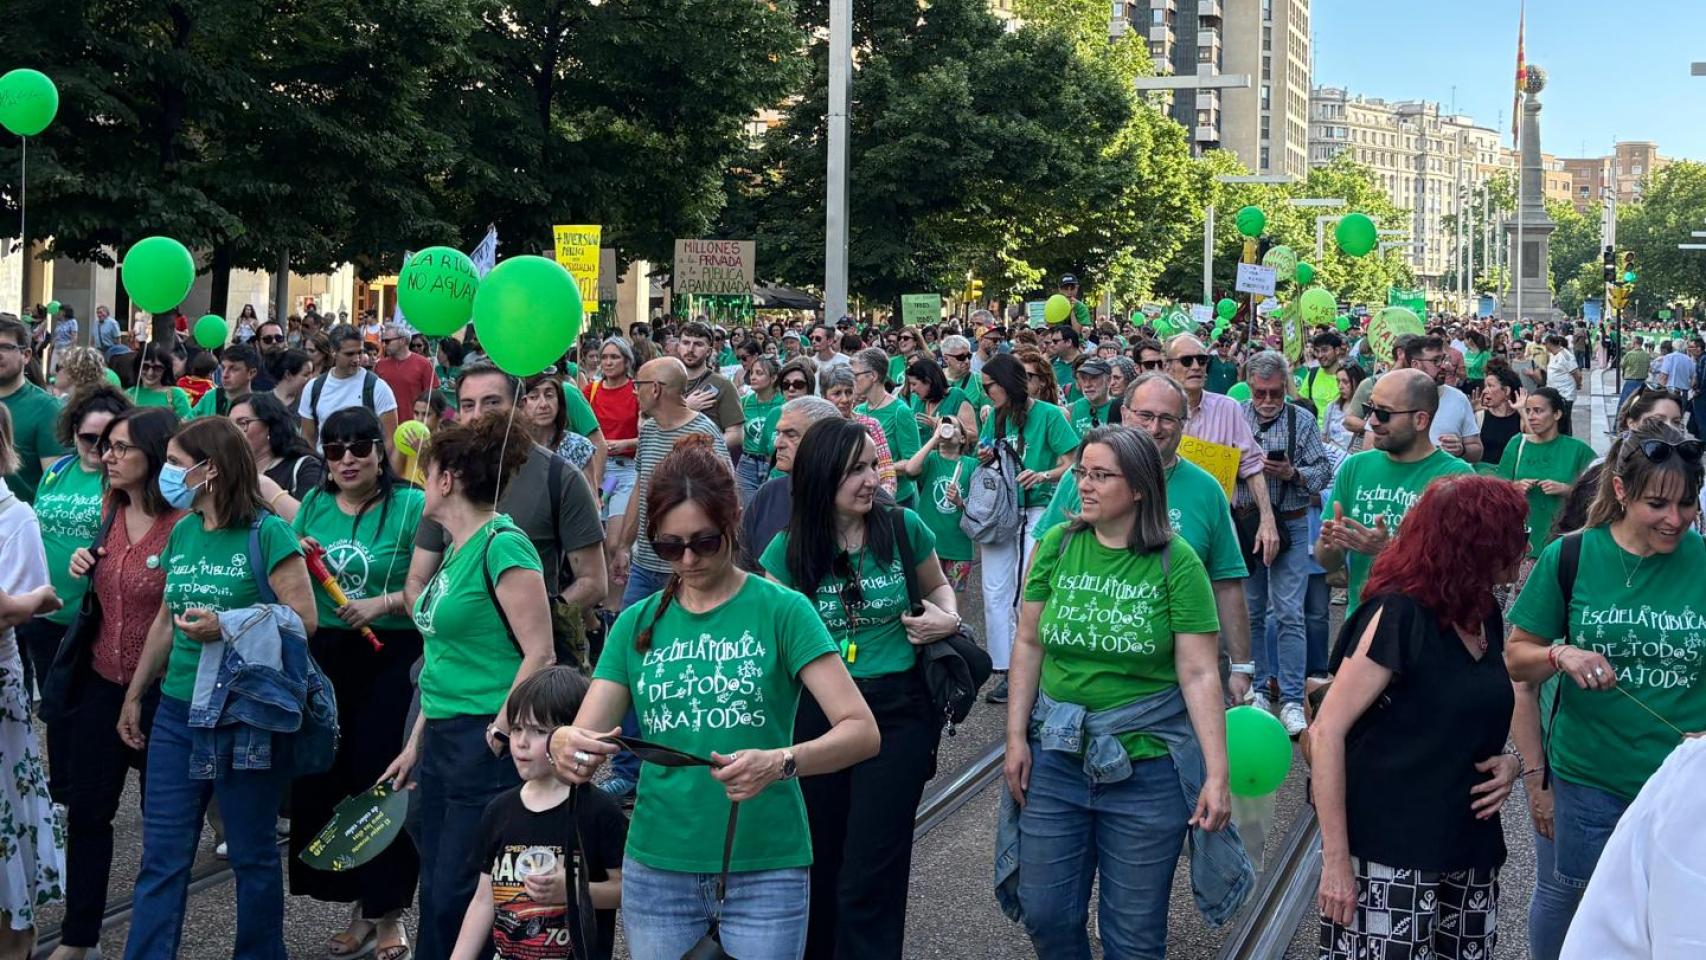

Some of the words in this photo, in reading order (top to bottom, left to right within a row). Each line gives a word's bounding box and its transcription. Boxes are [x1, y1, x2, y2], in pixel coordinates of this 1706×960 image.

[684, 241, 741, 255] MILLONES
[699, 255, 743, 268] PRIVADA
[407, 273, 426, 291] NO
[1057, 571, 1110, 596] ESCUELA
[1056, 605, 1081, 621] DE
[1086, 607, 1145, 628] TOD@S
[1581, 603, 1649, 628] ESCUELA
[643, 637, 706, 667] ESCUELA
[1042, 627, 1087, 647] PARA
[1089, 632, 1156, 656] TOD@S
[1627, 641, 1698, 662] TOD@S
[649, 681, 675, 703] DE
[682, 673, 755, 697] TOD@S
[692, 707, 766, 733] TOD@S
[544, 928, 571, 947] 70
